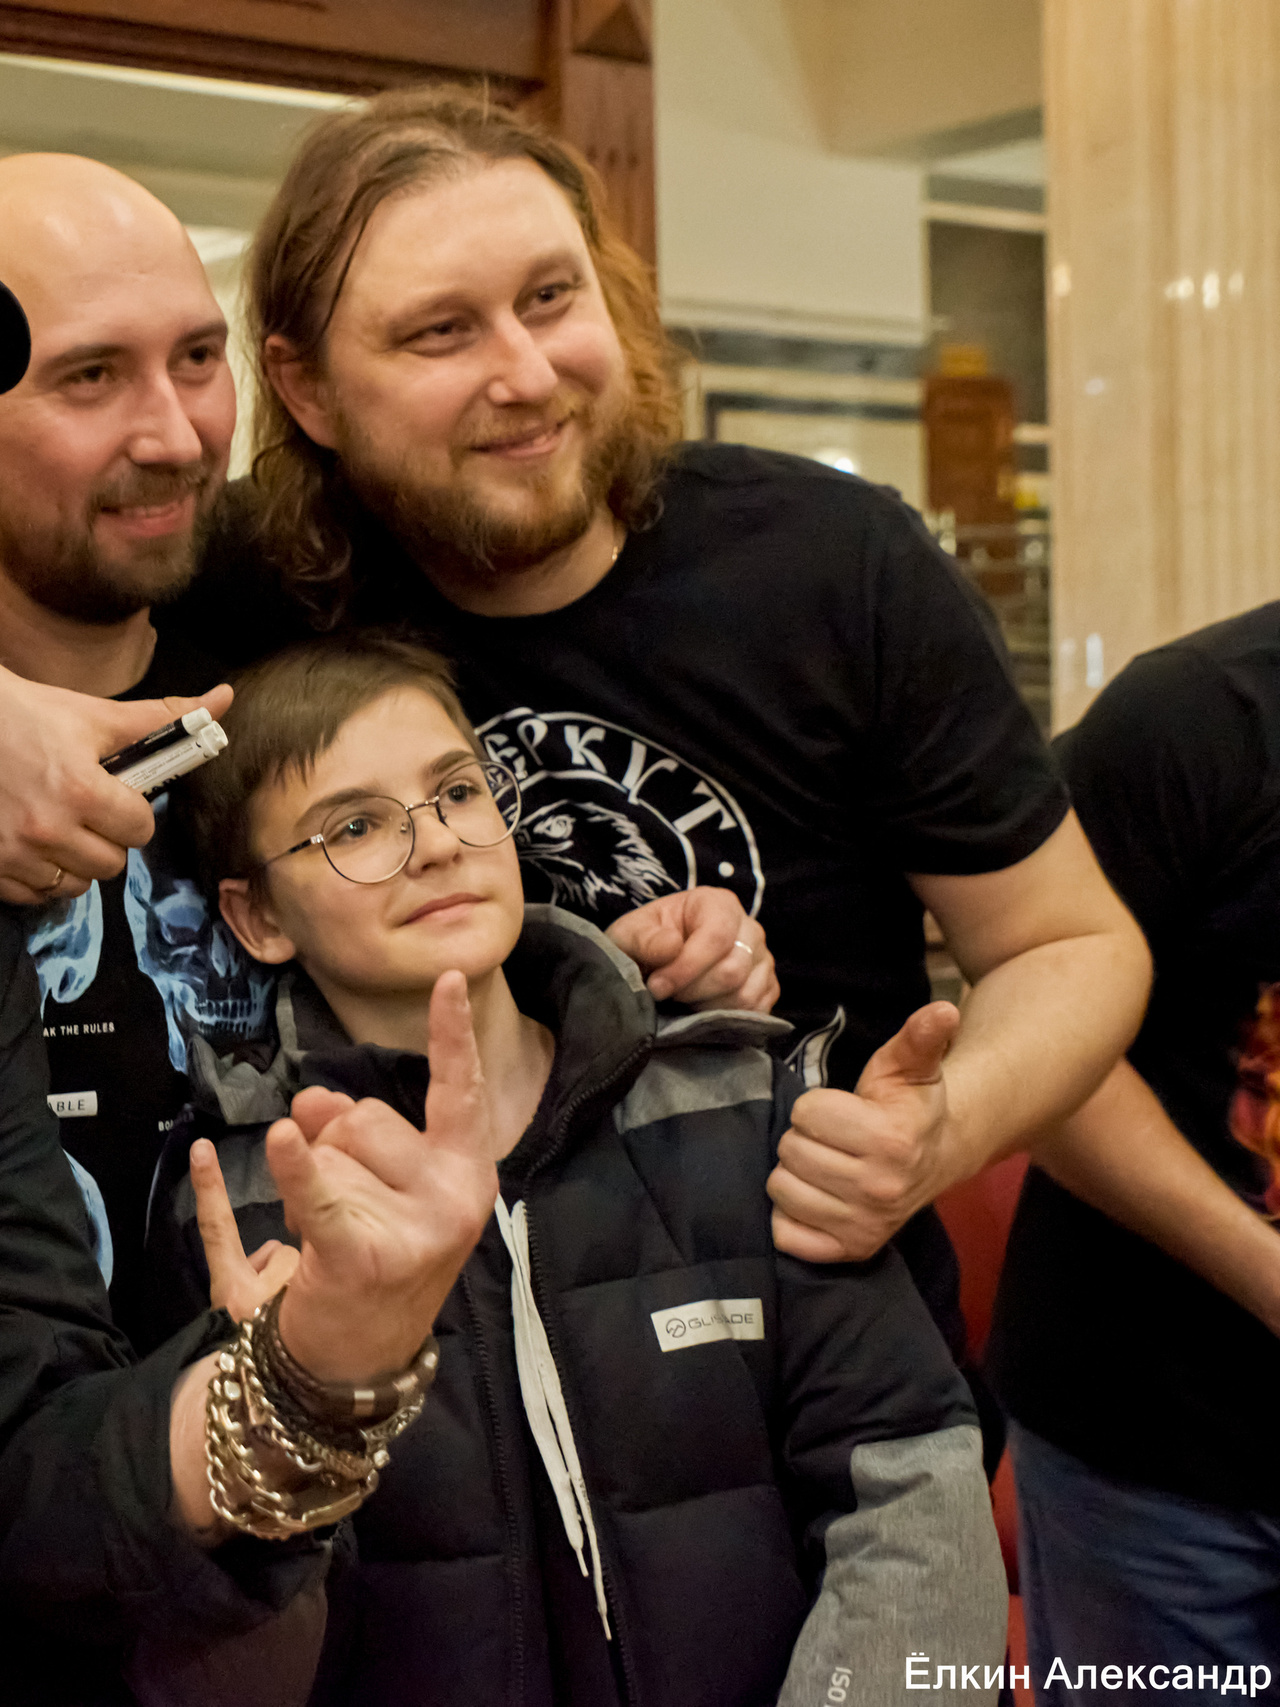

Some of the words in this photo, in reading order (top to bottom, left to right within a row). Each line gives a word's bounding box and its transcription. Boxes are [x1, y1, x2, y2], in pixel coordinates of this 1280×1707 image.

[484, 719, 737, 835] ЕРКУТ
[43, 1026, 57, 1038] AK
[60, 1024, 80, 1036] THE
[83, 1021, 115, 1034] RULES
[824, 1666, 853, 1707] ISO
